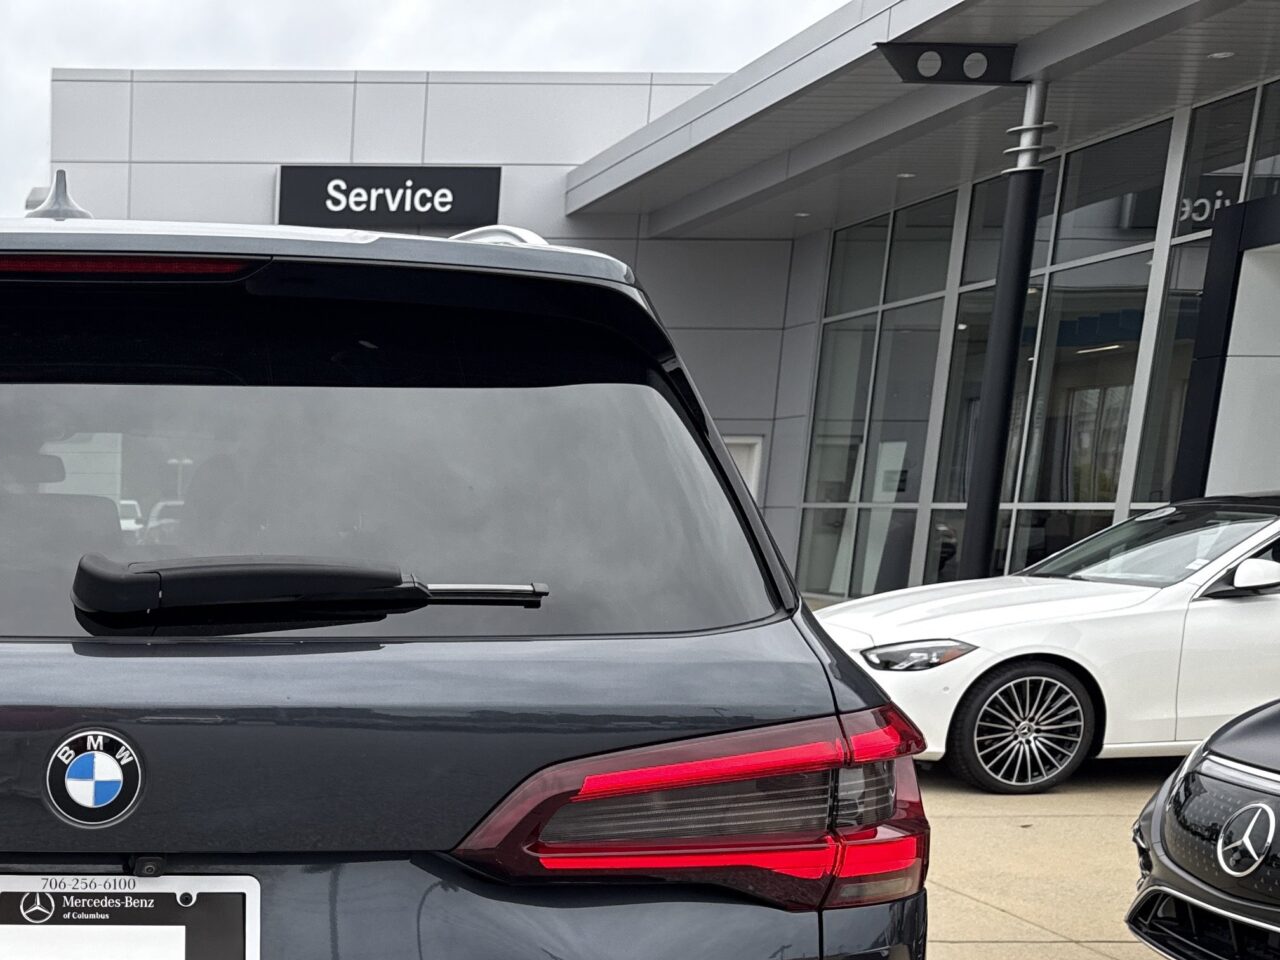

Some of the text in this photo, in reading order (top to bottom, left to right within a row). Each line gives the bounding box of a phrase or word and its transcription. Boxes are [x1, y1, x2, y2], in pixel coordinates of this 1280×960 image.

[324, 178, 454, 212] Service
[57, 735, 134, 766] BMW
[40, 877, 137, 891] 706-256-6100
[62, 895, 155, 908] Mercedes-Benz
[62, 911, 110, 920] of Columbus
